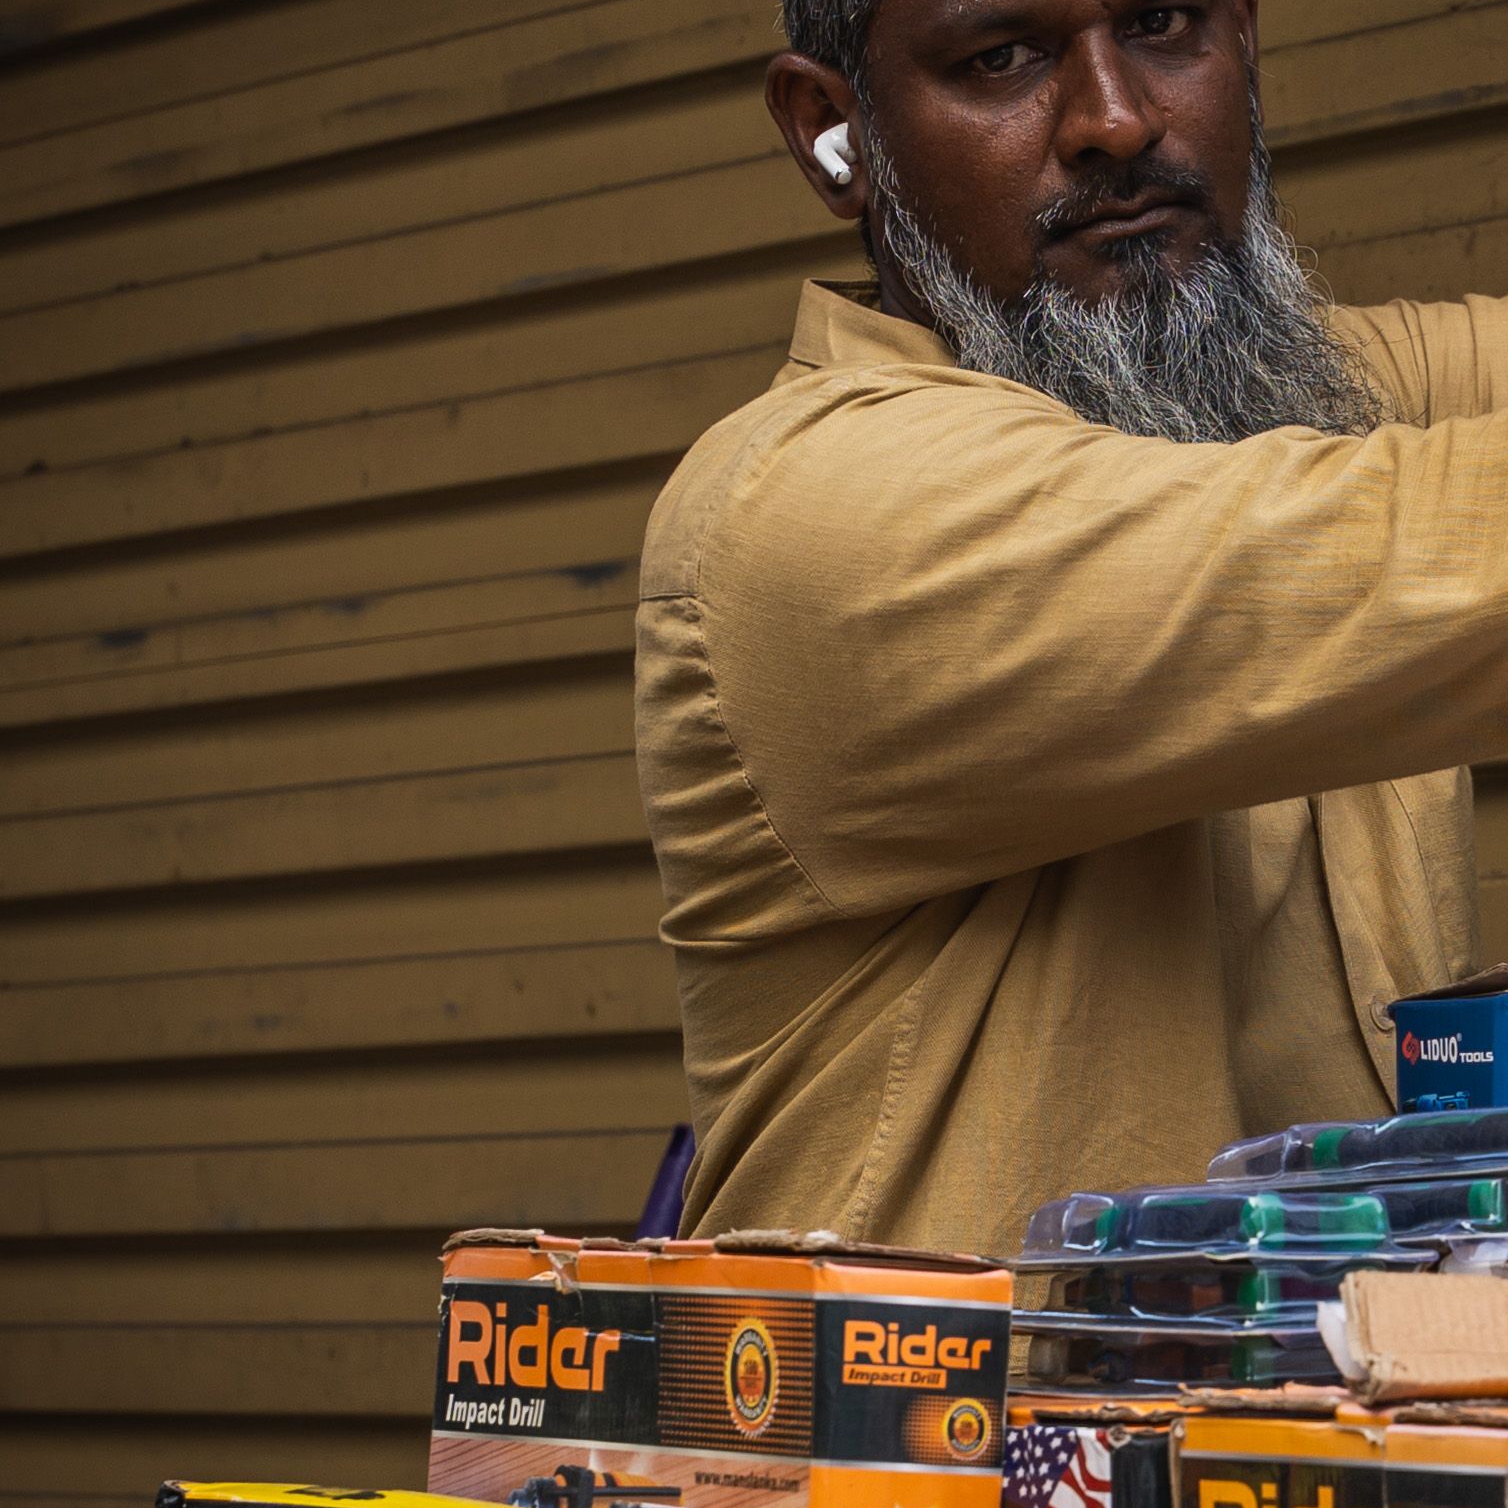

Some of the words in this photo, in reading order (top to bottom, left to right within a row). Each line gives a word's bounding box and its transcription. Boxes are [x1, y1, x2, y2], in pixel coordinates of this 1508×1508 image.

[1420, 1036, 1458, 1064] LIDUO
[1460, 1051, 1494, 1064] TOOLS
[446, 1300, 621, 1392] Rider
[842, 1320, 992, 1370] Rider
[846, 1368, 905, 1386] Impact
[909, 1369, 942, 1388] Drill
[445, 1393, 504, 1427] Impact
[507, 1397, 545, 1429] Drill
